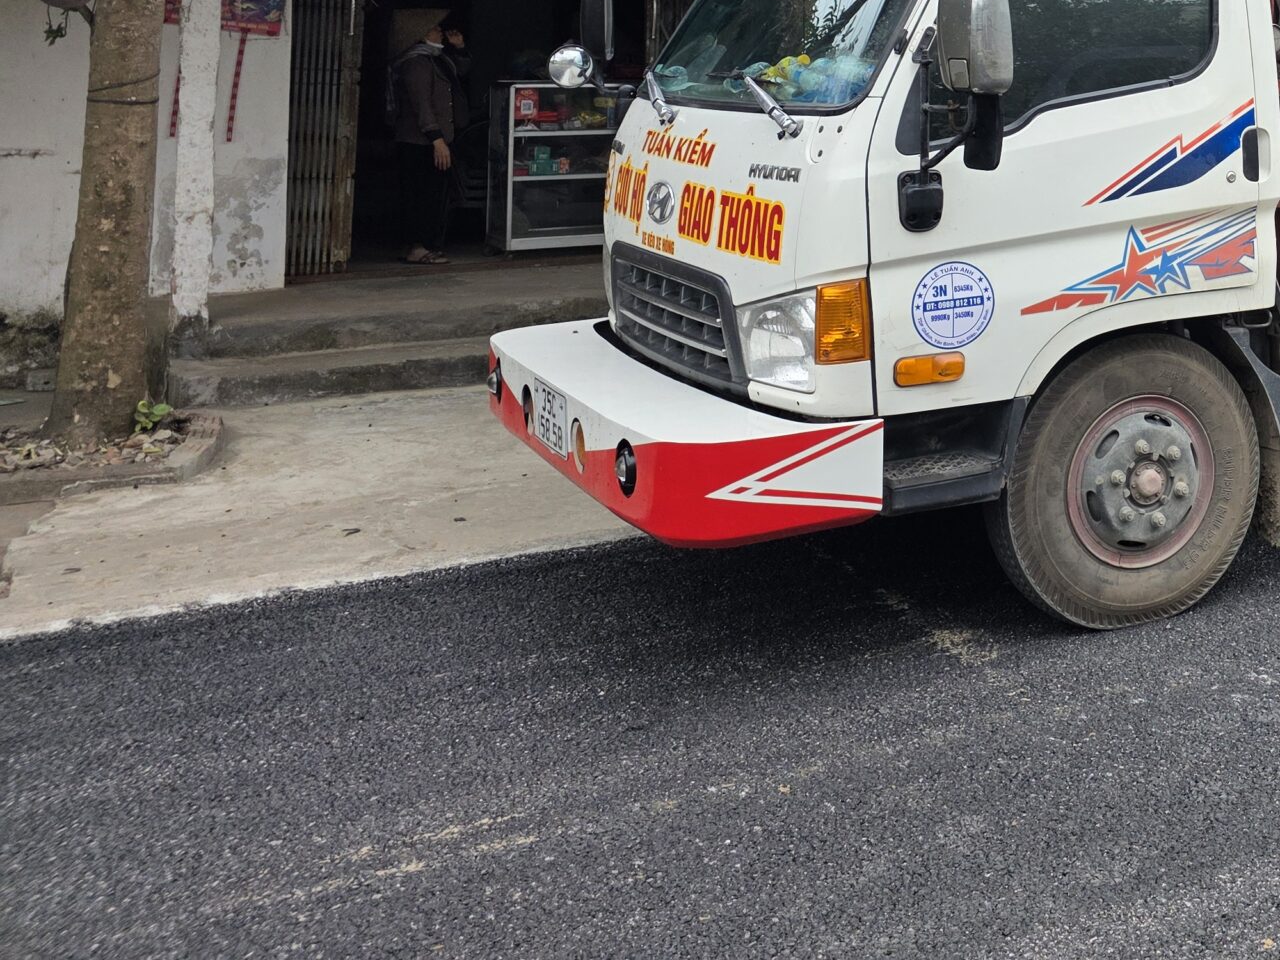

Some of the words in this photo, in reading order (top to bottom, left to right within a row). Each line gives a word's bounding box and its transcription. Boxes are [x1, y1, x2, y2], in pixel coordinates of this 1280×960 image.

[749, 163, 801, 183] HYUNDAI
[677, 182, 716, 245] GIAO
[717, 185, 784, 263] THÔNG
[960, 266, 974, 276] ANH
[932, 284, 948, 298] 3N
[541, 388, 557, 418] 35C
